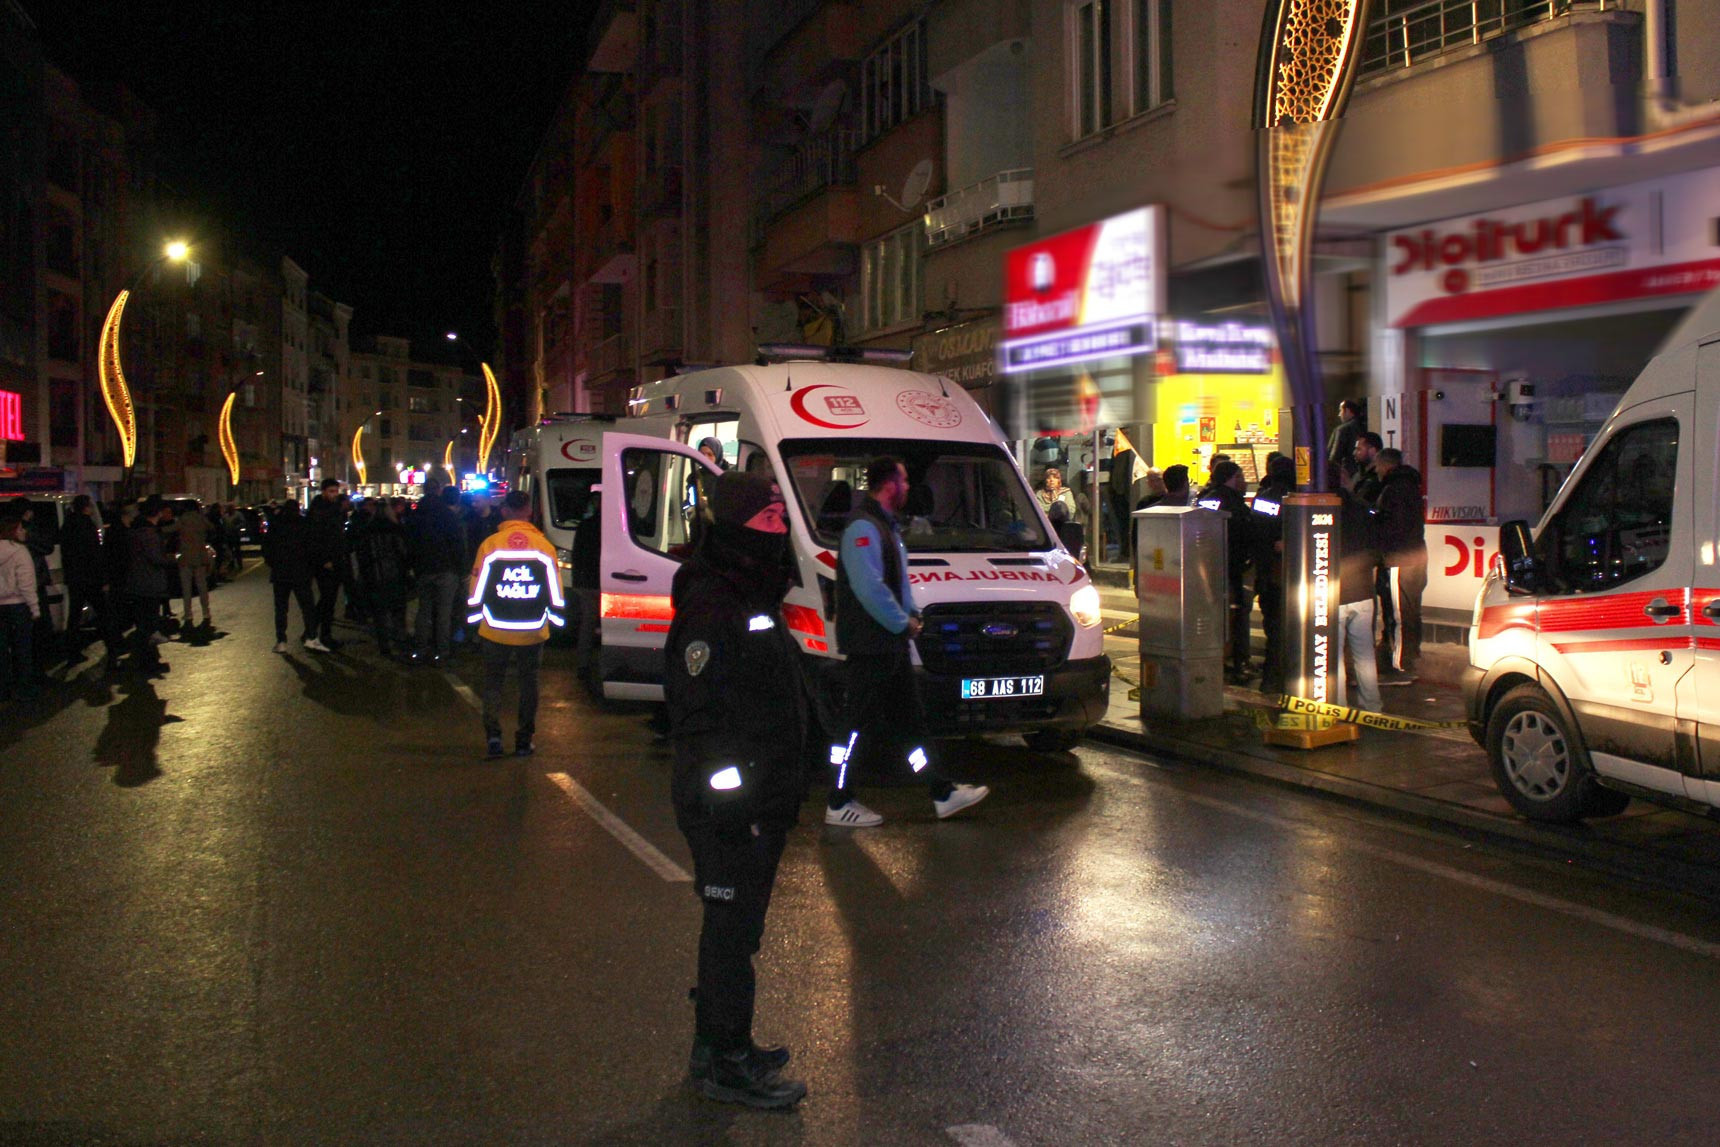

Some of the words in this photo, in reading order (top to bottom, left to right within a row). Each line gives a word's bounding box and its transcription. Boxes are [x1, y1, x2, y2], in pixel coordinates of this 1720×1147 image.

[830, 397, 856, 407] 112
[1432, 505, 1486, 518] HIKVISION
[970, 680, 986, 696] 68
[992, 680, 1013, 695] AAS
[1021, 677, 1041, 694] 112
